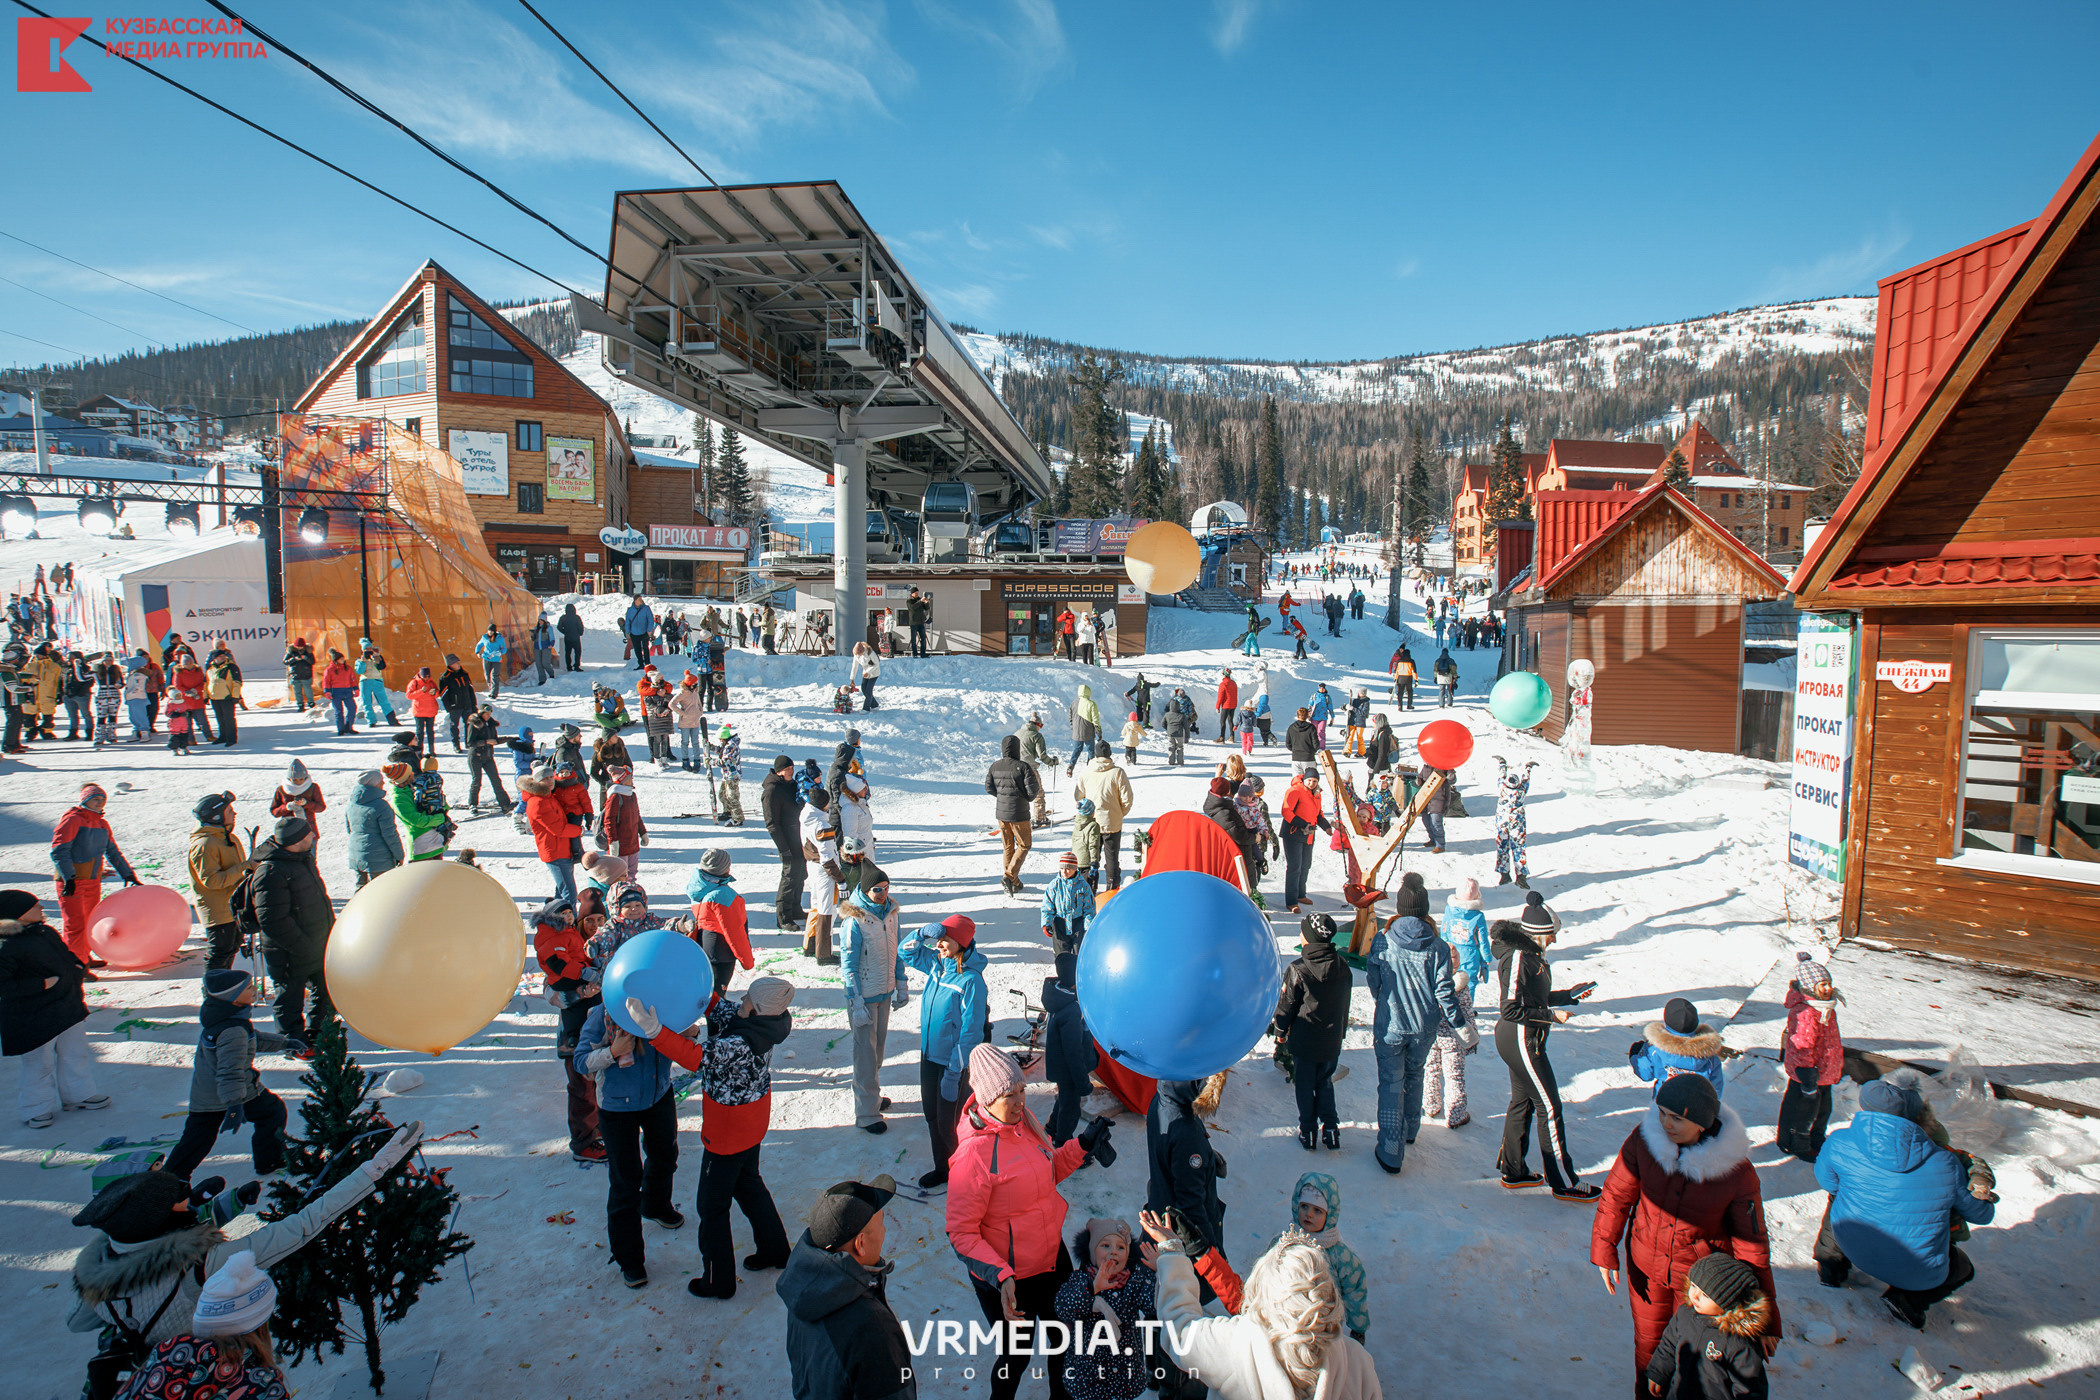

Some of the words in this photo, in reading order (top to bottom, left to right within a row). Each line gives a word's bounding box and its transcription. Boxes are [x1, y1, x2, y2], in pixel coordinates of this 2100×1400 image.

[466, 448, 491, 457] Туры
[470, 457, 496, 465] отель
[462, 463, 496, 472] Сугроб
[601, 533, 645, 547] Сугроб
[652, 527, 707, 545] ПРОКАТ
[1110, 531, 1135, 539] BELK
[866, 586, 883, 597] ССЫ
[1878, 667, 1947, 678] СНЕЖНАЯ
[1799, 681, 1843, 698] ИГРОВАЯ
[1900, 678, 1920, 690] 44
[1797, 715, 1842, 736] ПРОКАТ
[1795, 748, 1840, 773] ИНСТРУКТОР
[1795, 781, 1838, 809] СЕРВИС
